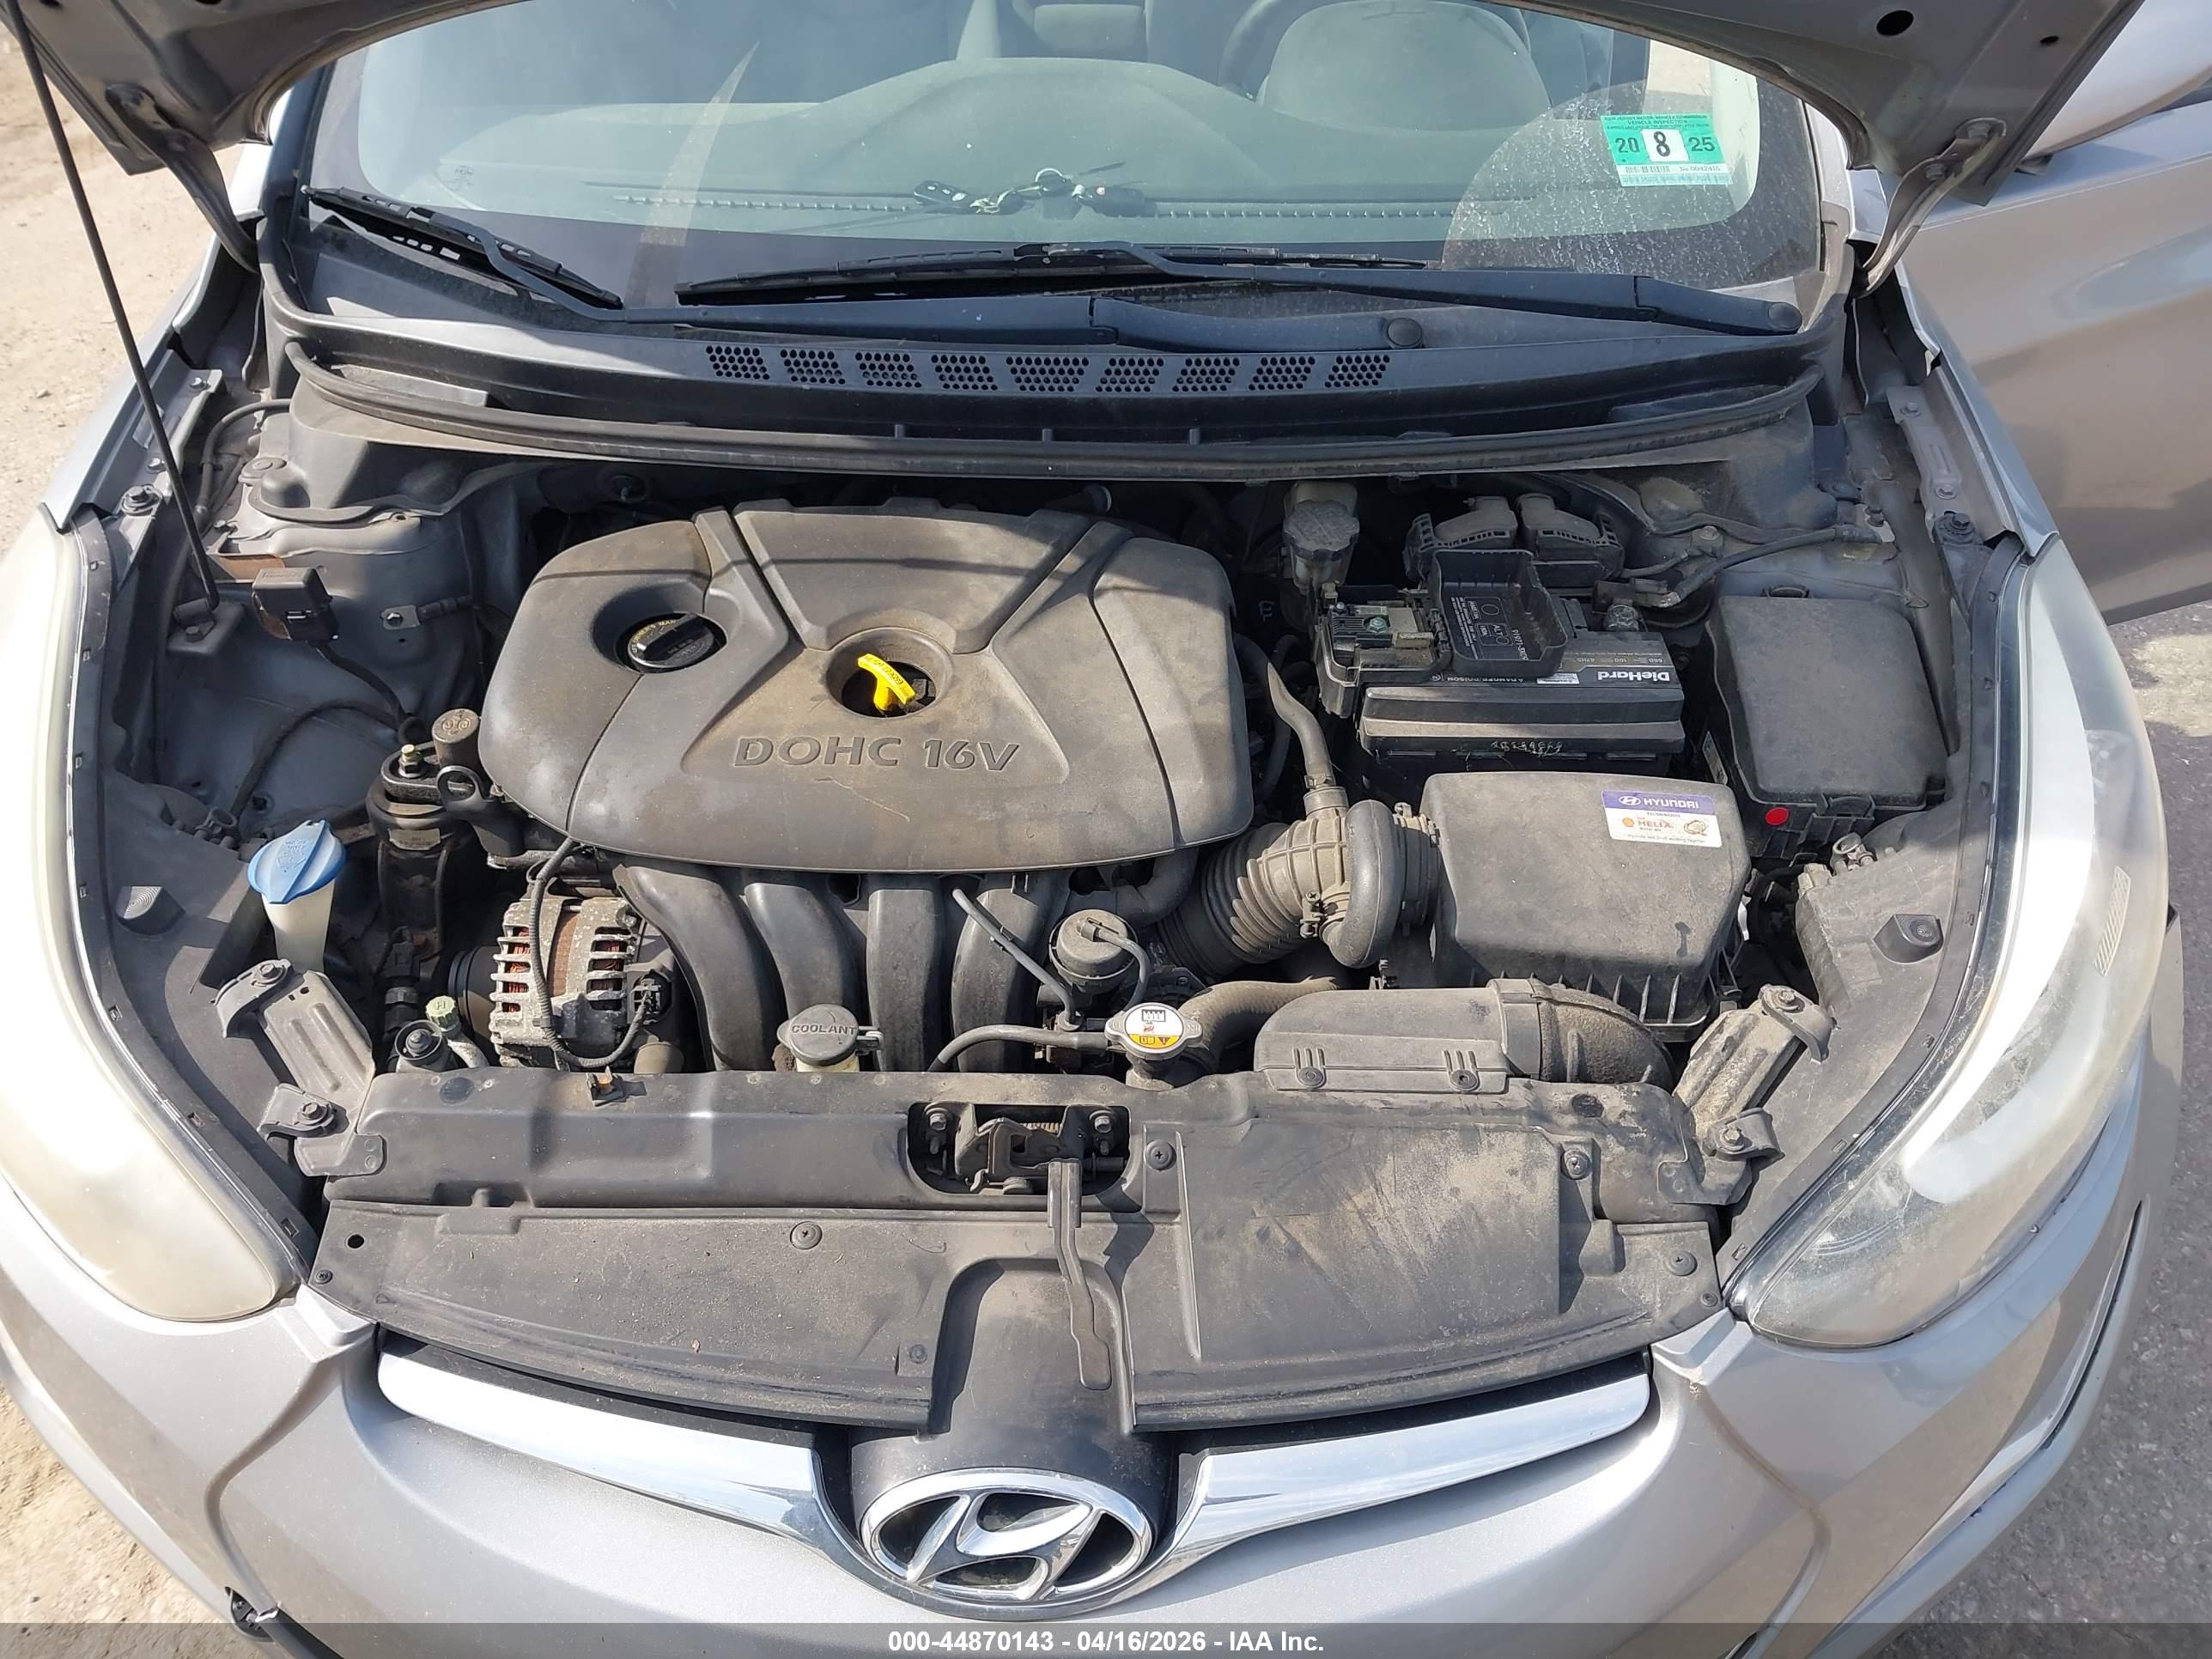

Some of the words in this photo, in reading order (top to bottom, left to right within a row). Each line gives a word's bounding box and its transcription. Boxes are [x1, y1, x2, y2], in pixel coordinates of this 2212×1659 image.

[1615, 137, 1640, 153] 20
[1653, 131, 1671, 157] 8
[1688, 137, 1715, 152] 25
[1492, 624, 1504, 636] ALT
[1597, 671, 1670, 682] DieHard
[734, 737, 902, 767] DOHC
[922, 738, 1019, 771] 16V
[1644, 797, 1699, 810] HYUNDAI
[791, 1024, 857, 1036] COOLANT
